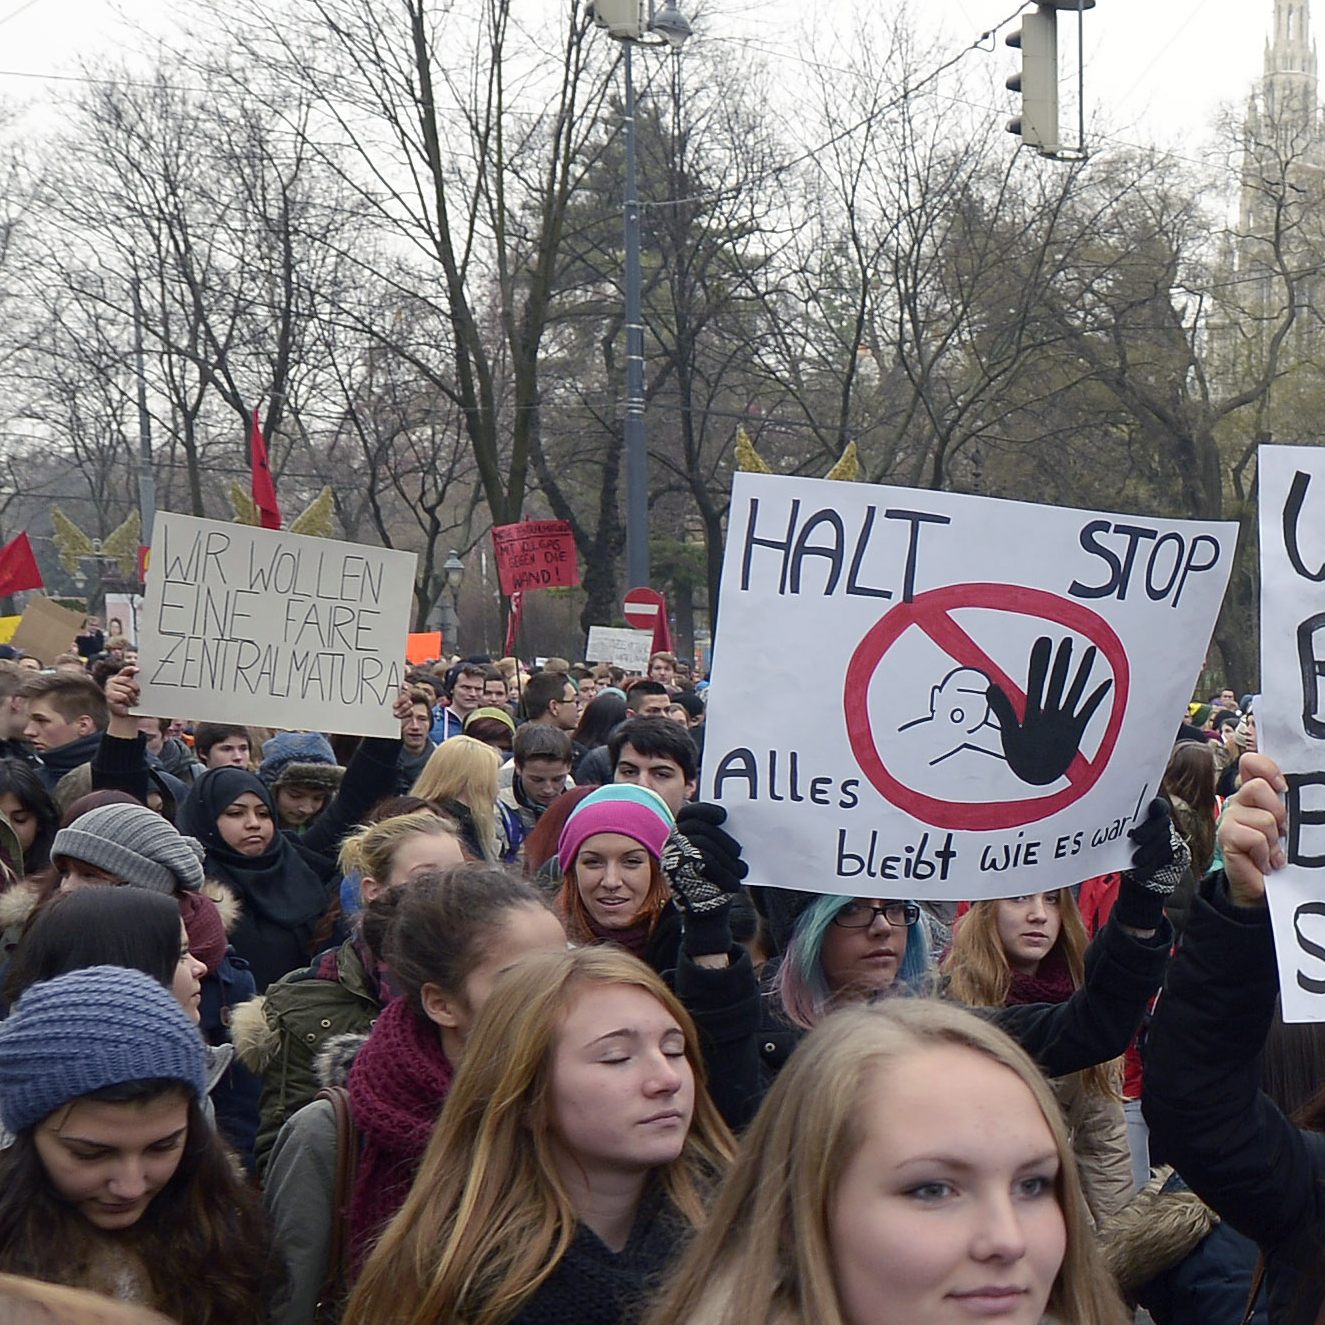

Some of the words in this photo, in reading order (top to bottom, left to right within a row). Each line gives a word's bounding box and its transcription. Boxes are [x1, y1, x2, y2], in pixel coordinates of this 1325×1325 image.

[164, 524, 230, 584] WIR
[248, 541, 383, 604] WOLLEN
[544, 551, 567, 563] DIE
[741, 498, 951, 604] HALT
[1068, 520, 1221, 608] STOP
[158, 580, 261, 641] EINE
[284, 598, 381, 652] FAIRE
[150, 634, 400, 706] ZENTRALMATURA
[1054, 830, 1084, 859] ES
